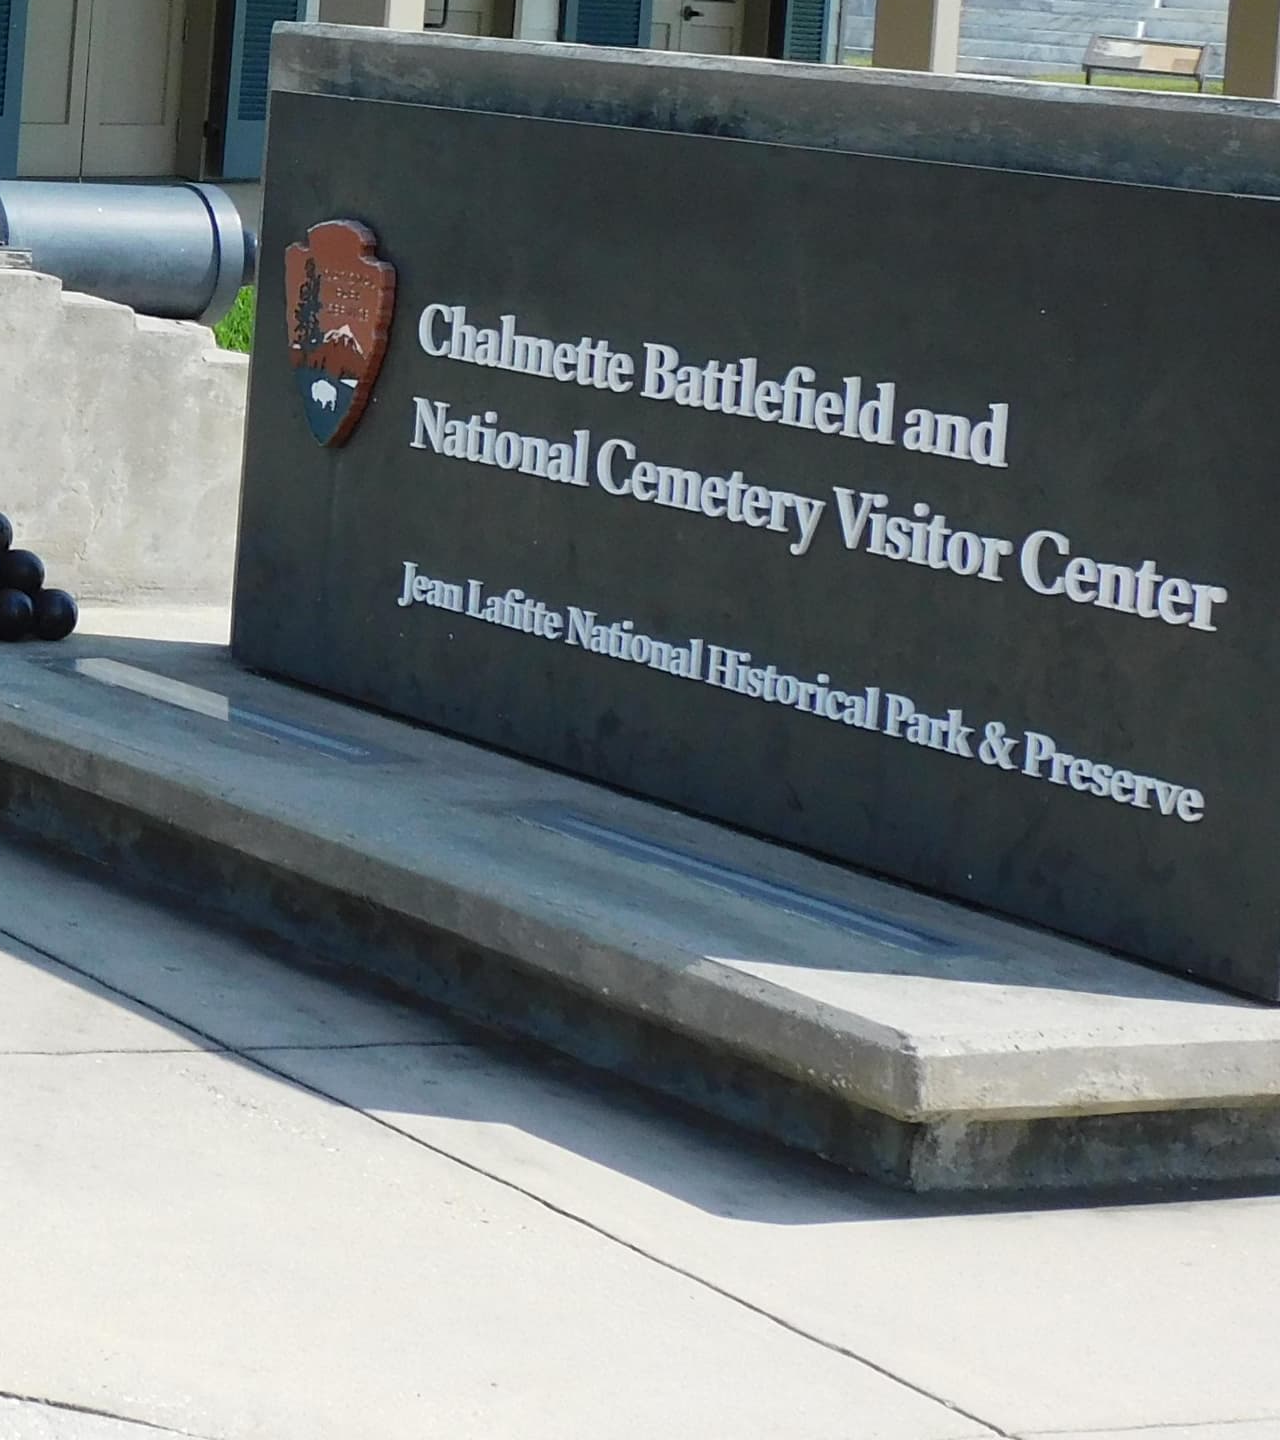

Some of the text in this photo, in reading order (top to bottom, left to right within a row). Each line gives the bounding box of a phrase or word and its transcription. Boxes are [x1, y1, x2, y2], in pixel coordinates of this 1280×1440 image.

[417, 303, 1009, 469] Chalmette Battlefield and
[409, 396, 1228, 632] National Cemetery Visitor Center
[397, 561, 1206, 823] Jean Lafitte National Historical Park & Preserve
